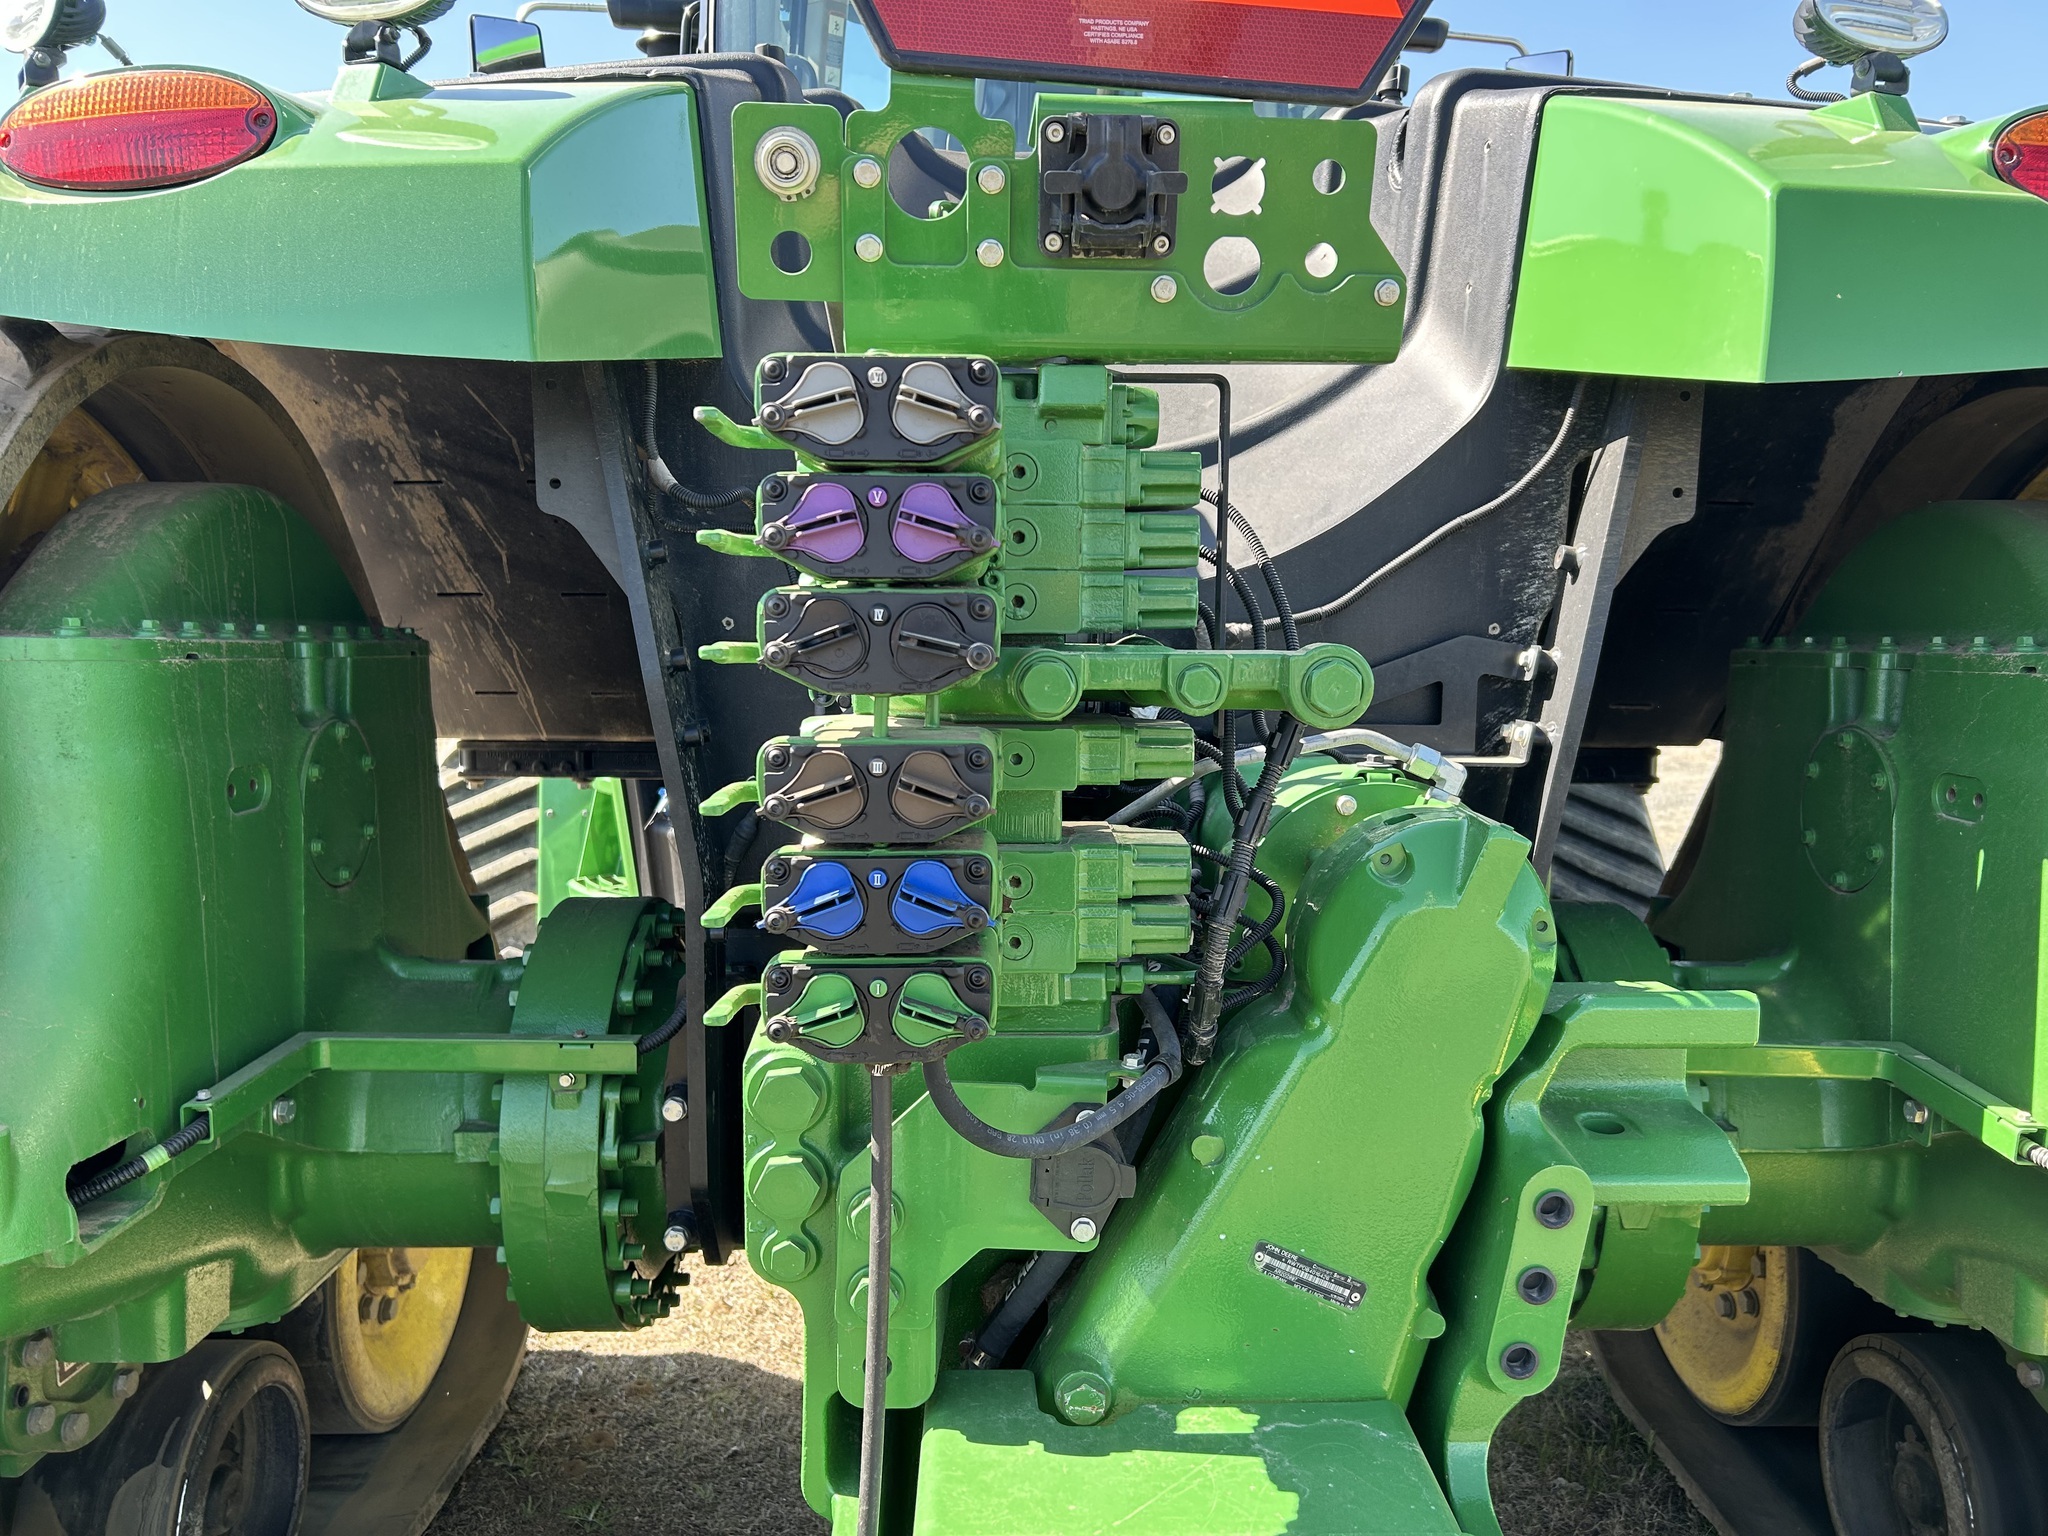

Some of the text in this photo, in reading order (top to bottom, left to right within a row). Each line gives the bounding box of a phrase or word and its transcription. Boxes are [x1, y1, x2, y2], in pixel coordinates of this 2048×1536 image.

[871, 491, 883, 504] V
[874, 608, 884, 621] IV
[872, 761, 883, 774] III
[873, 874, 882, 884] II
[875, 983, 882, 995] I
[1095, 1112, 1107, 1121] mm
[1007, 1134, 1018, 1142] 28
[1075, 1157, 1095, 1203] Pollak
[1265, 1243, 1281, 1254] JOHN
[1280, 1249, 1299, 1261] DEERE
